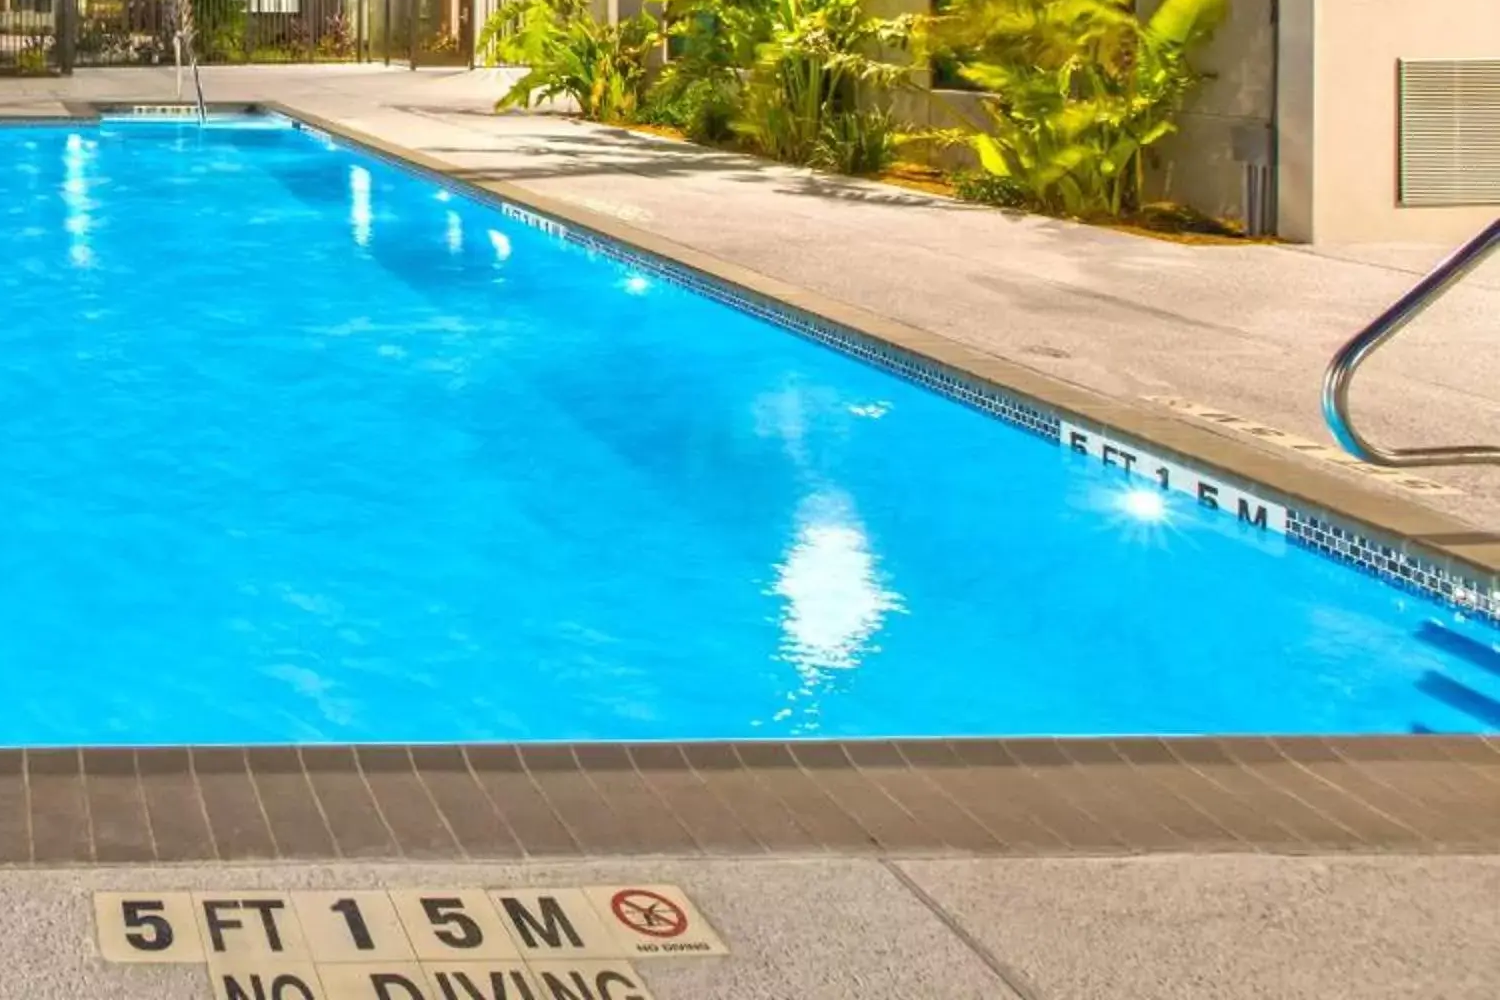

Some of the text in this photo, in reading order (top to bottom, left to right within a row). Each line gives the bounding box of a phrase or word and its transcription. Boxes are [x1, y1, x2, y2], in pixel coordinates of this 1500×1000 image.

[1070, 431, 1268, 531] 5 FT 1 5 M
[121, 896, 586, 952] 5 FT 1 5 M
[636, 941, 711, 953] NO DIVING
